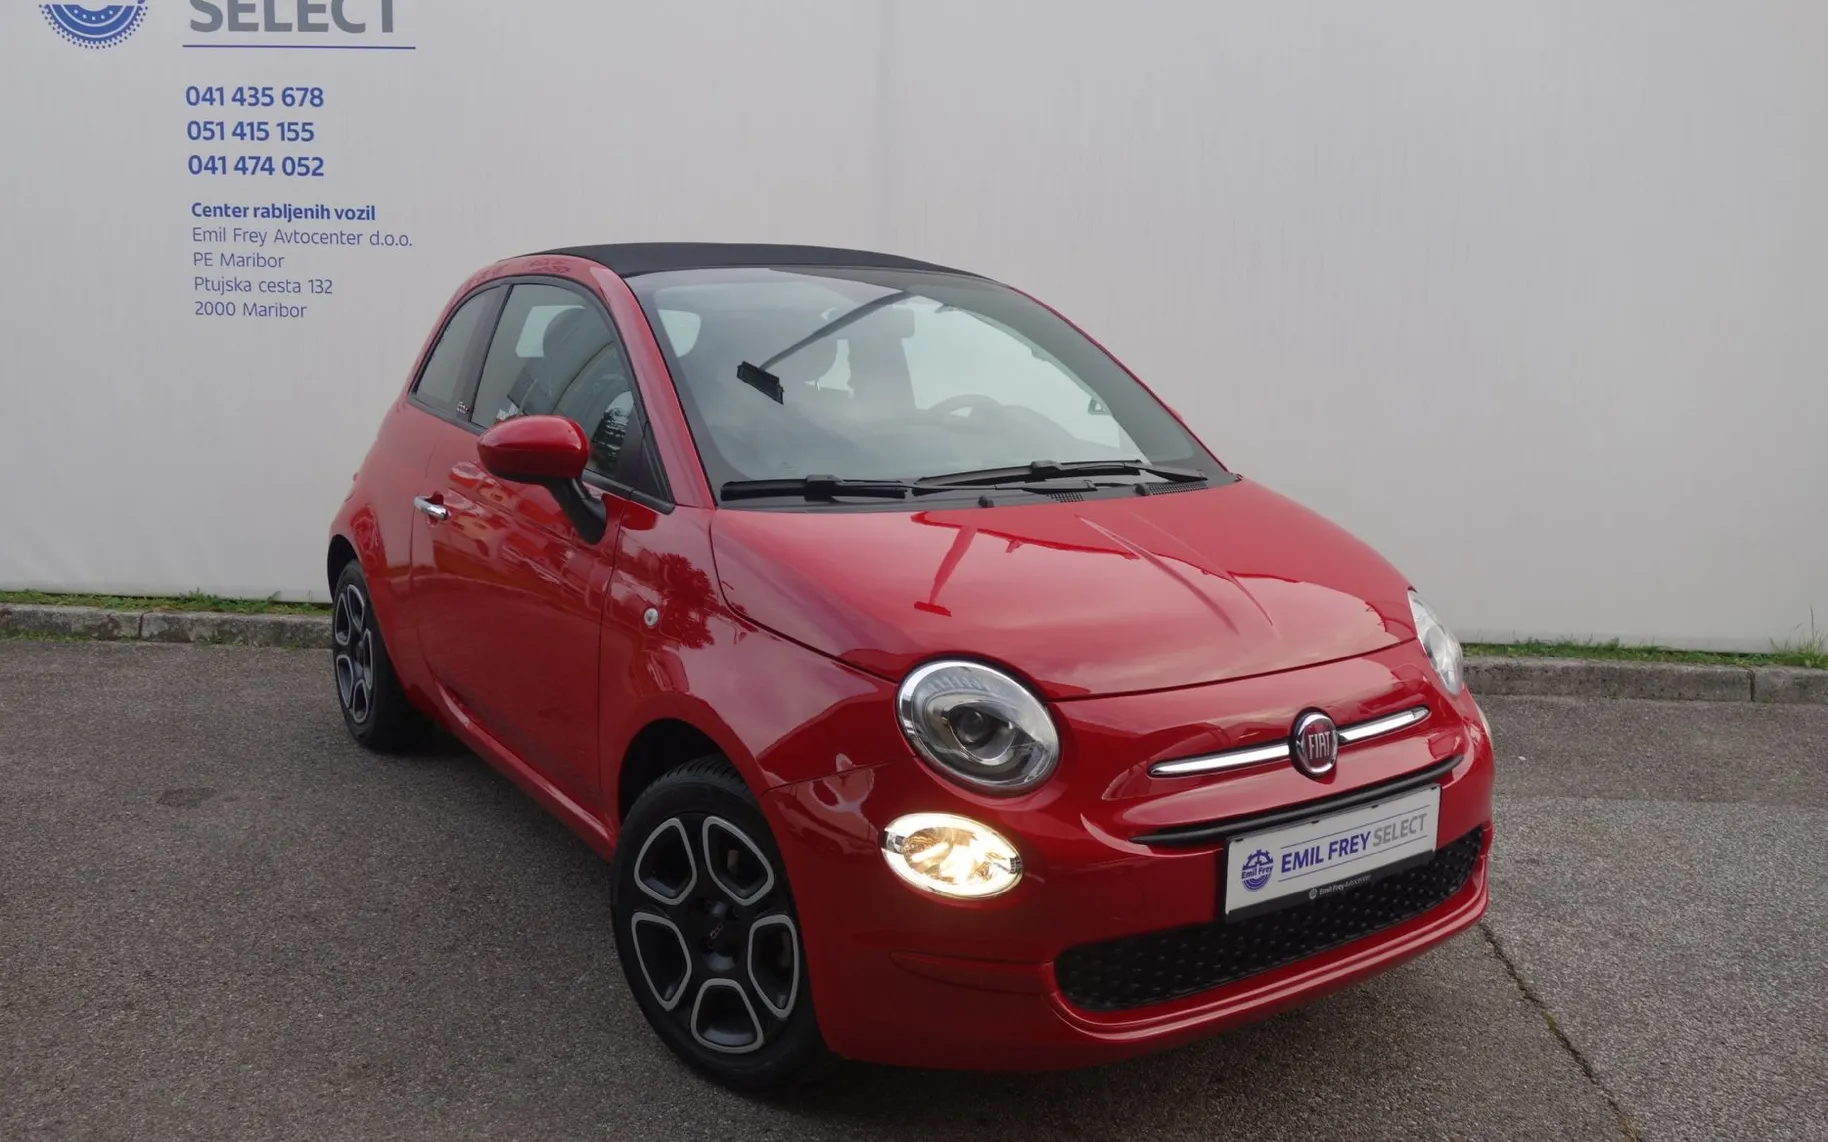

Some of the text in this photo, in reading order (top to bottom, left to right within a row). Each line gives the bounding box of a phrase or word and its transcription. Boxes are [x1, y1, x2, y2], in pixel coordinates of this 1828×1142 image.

[185, 86, 325, 108] 041 435 678
[187, 120, 315, 142] 051 415 155
[188, 155, 325, 177] 041 474 052
[191, 202, 376, 224] Center rabljenih vozil
[192, 227, 413, 248] Emil Frey Avtocenter d.o.o.
[193, 252, 285, 268] PE Maribor
[194, 276, 333, 296] Ptujska cesta 132
[194, 301, 307, 318] 2000 Maribor
[1308, 731, 1330, 760] FIAT
[1281, 813, 1427, 873] EMIL FREY SELECT
[1241, 865, 1273, 879] Emil Frey
